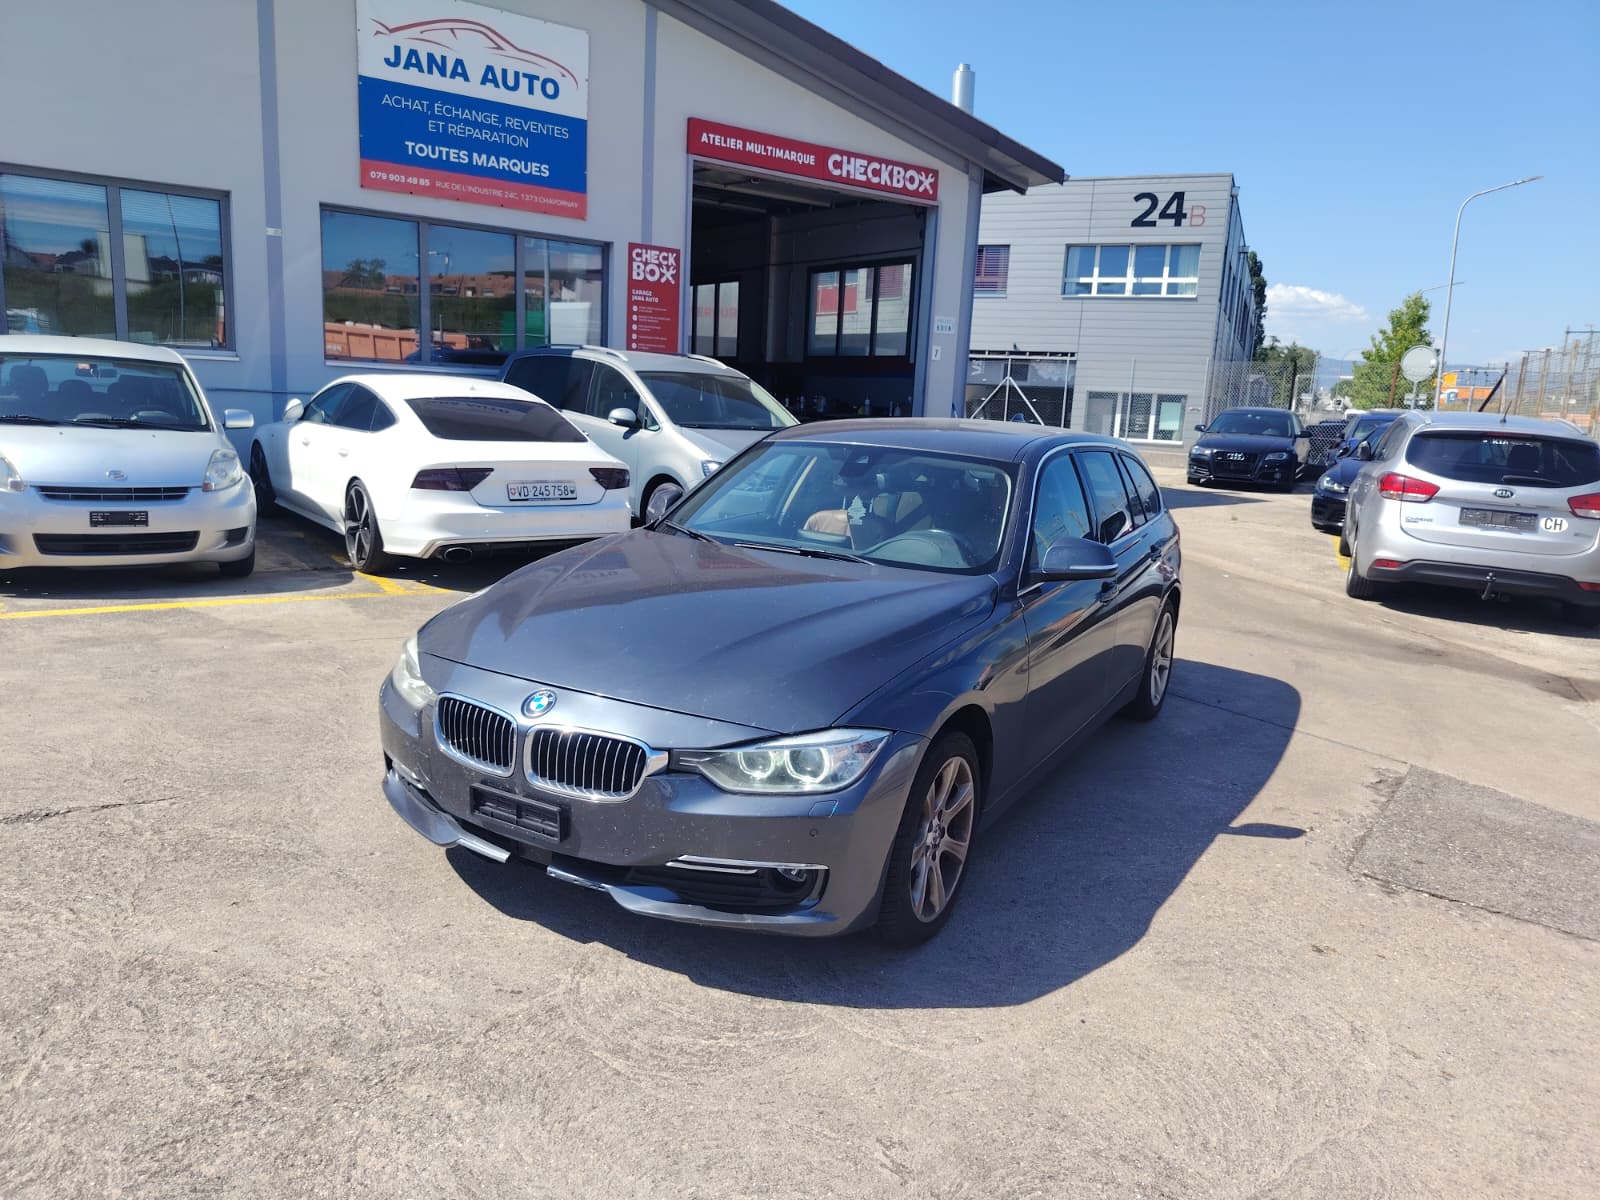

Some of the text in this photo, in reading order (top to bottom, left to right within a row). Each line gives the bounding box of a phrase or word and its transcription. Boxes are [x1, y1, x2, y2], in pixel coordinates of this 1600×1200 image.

[383, 45, 560, 100] JANA AUTO
[381, 94, 569, 139] ACHAT, ÉCHANGE, REVENTES
[428, 120, 529, 148] ET RÉPARATION
[405, 141, 550, 177] TOUTES MARQUES
[701, 132, 935, 194] ATELIER MULTIMARQUE CHECKBOX
[435, 181, 450, 190] RUE
[632, 248, 676, 266] CHECK
[632, 261, 677, 284] BOX
[517, 486, 529, 497] VD
[1544, 517, 1563, 531] CH
